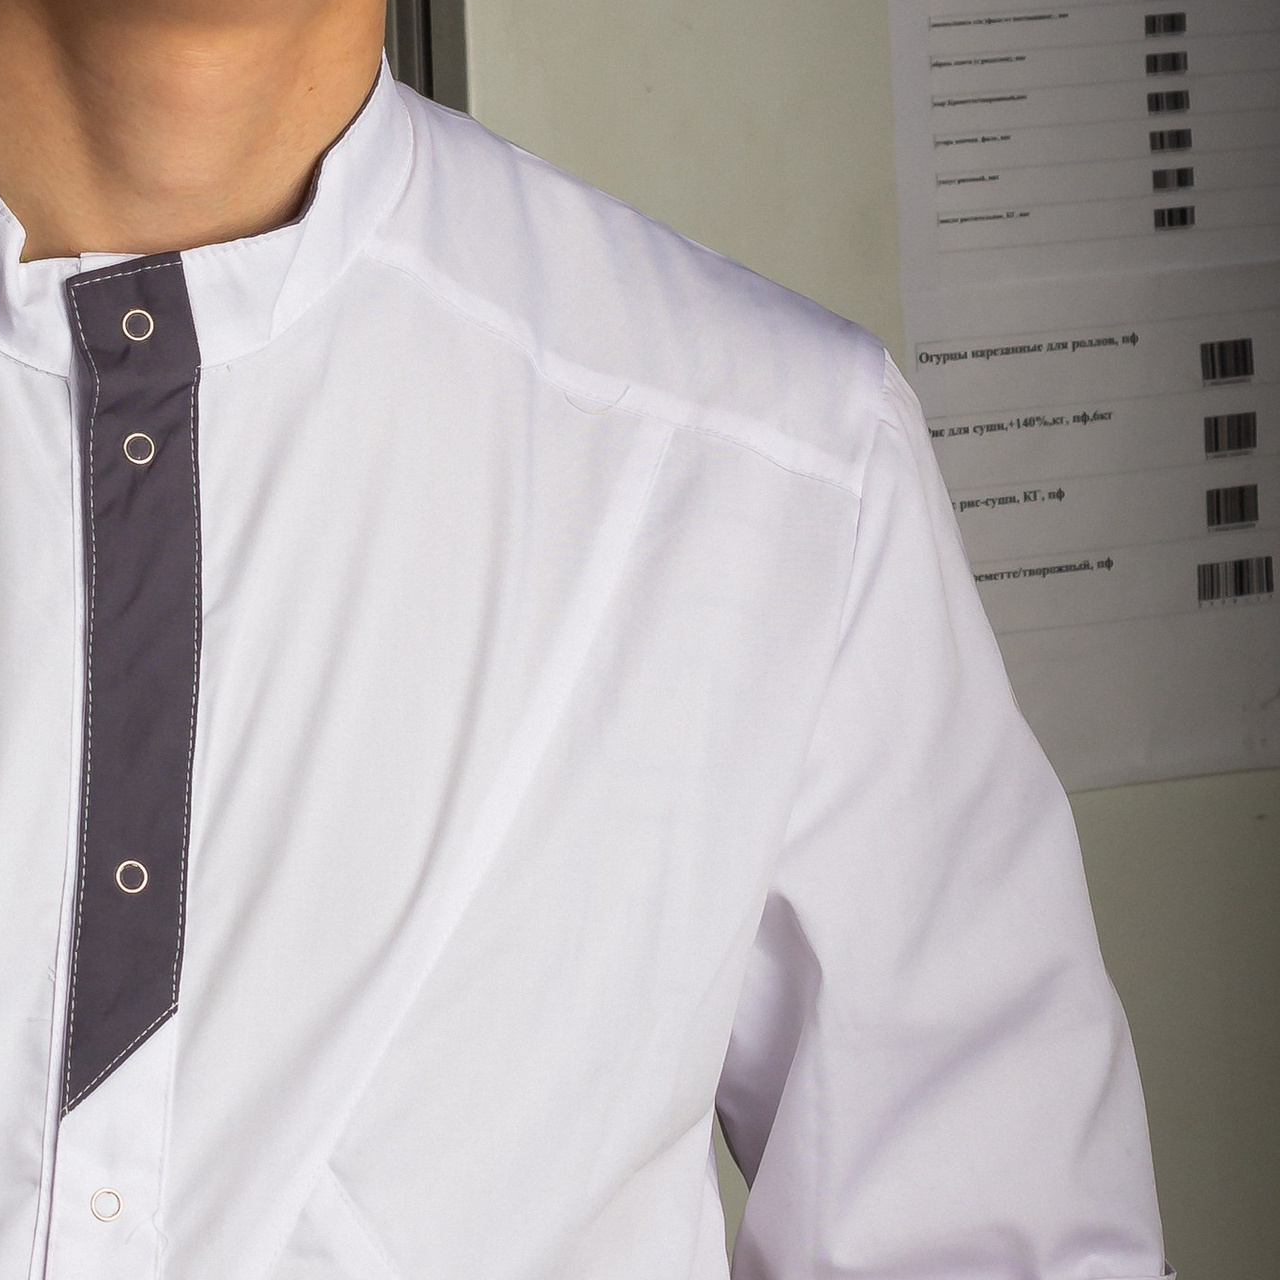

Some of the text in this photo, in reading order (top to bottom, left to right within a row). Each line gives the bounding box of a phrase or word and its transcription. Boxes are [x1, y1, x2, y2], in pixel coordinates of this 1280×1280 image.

[919, 351, 968, 365] Огурцы
[971, 342, 1044, 360] нарезанные
[1046, 341, 1069, 352] для
[1122, 332, 1139, 346] пф
[948, 426, 970, 437] для
[1048, 487, 1065, 502] пф
[1097, 557, 1114, 571] пф
